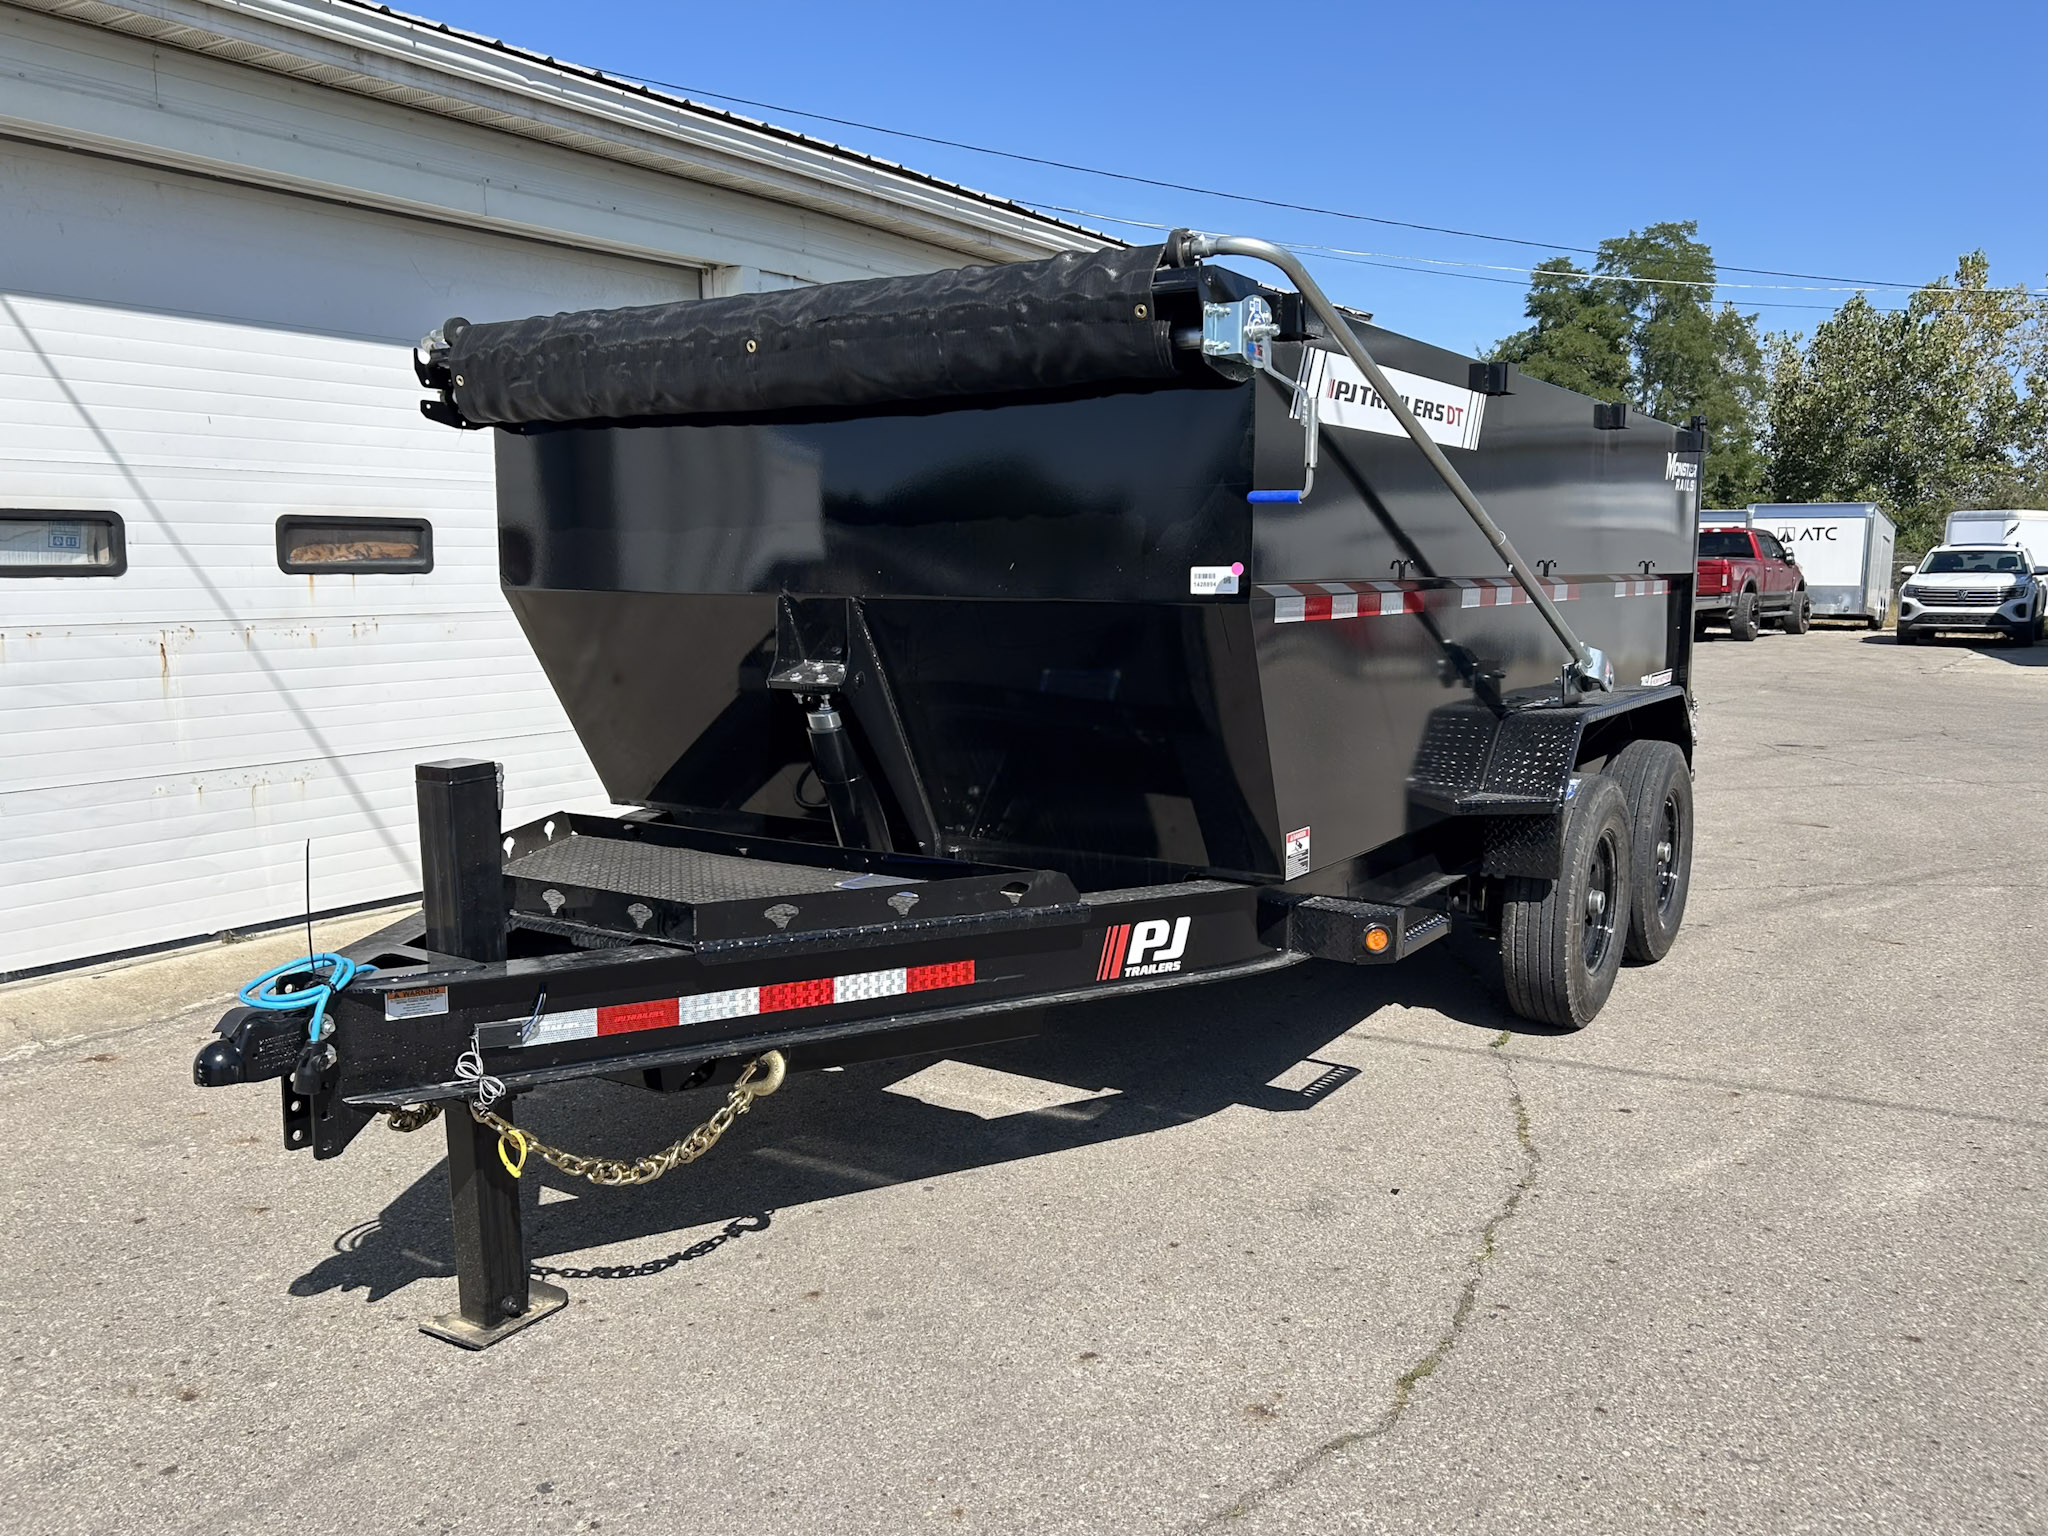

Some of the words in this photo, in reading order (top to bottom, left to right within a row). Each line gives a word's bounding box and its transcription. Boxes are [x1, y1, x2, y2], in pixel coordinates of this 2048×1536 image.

[1334, 380, 1358, 403] PJ
[1360, 385, 1445, 422] TRERS
[1446, 404, 1464, 427] DT
[1665, 452, 1698, 480] MONSTER
[1675, 479, 1695, 491] RAILS
[1799, 526, 1838, 541] ATC
[1126, 916, 1191, 965] PJ
[1124, 960, 1182, 978] TRAILERS
[403, 987, 441, 998] WARNING
